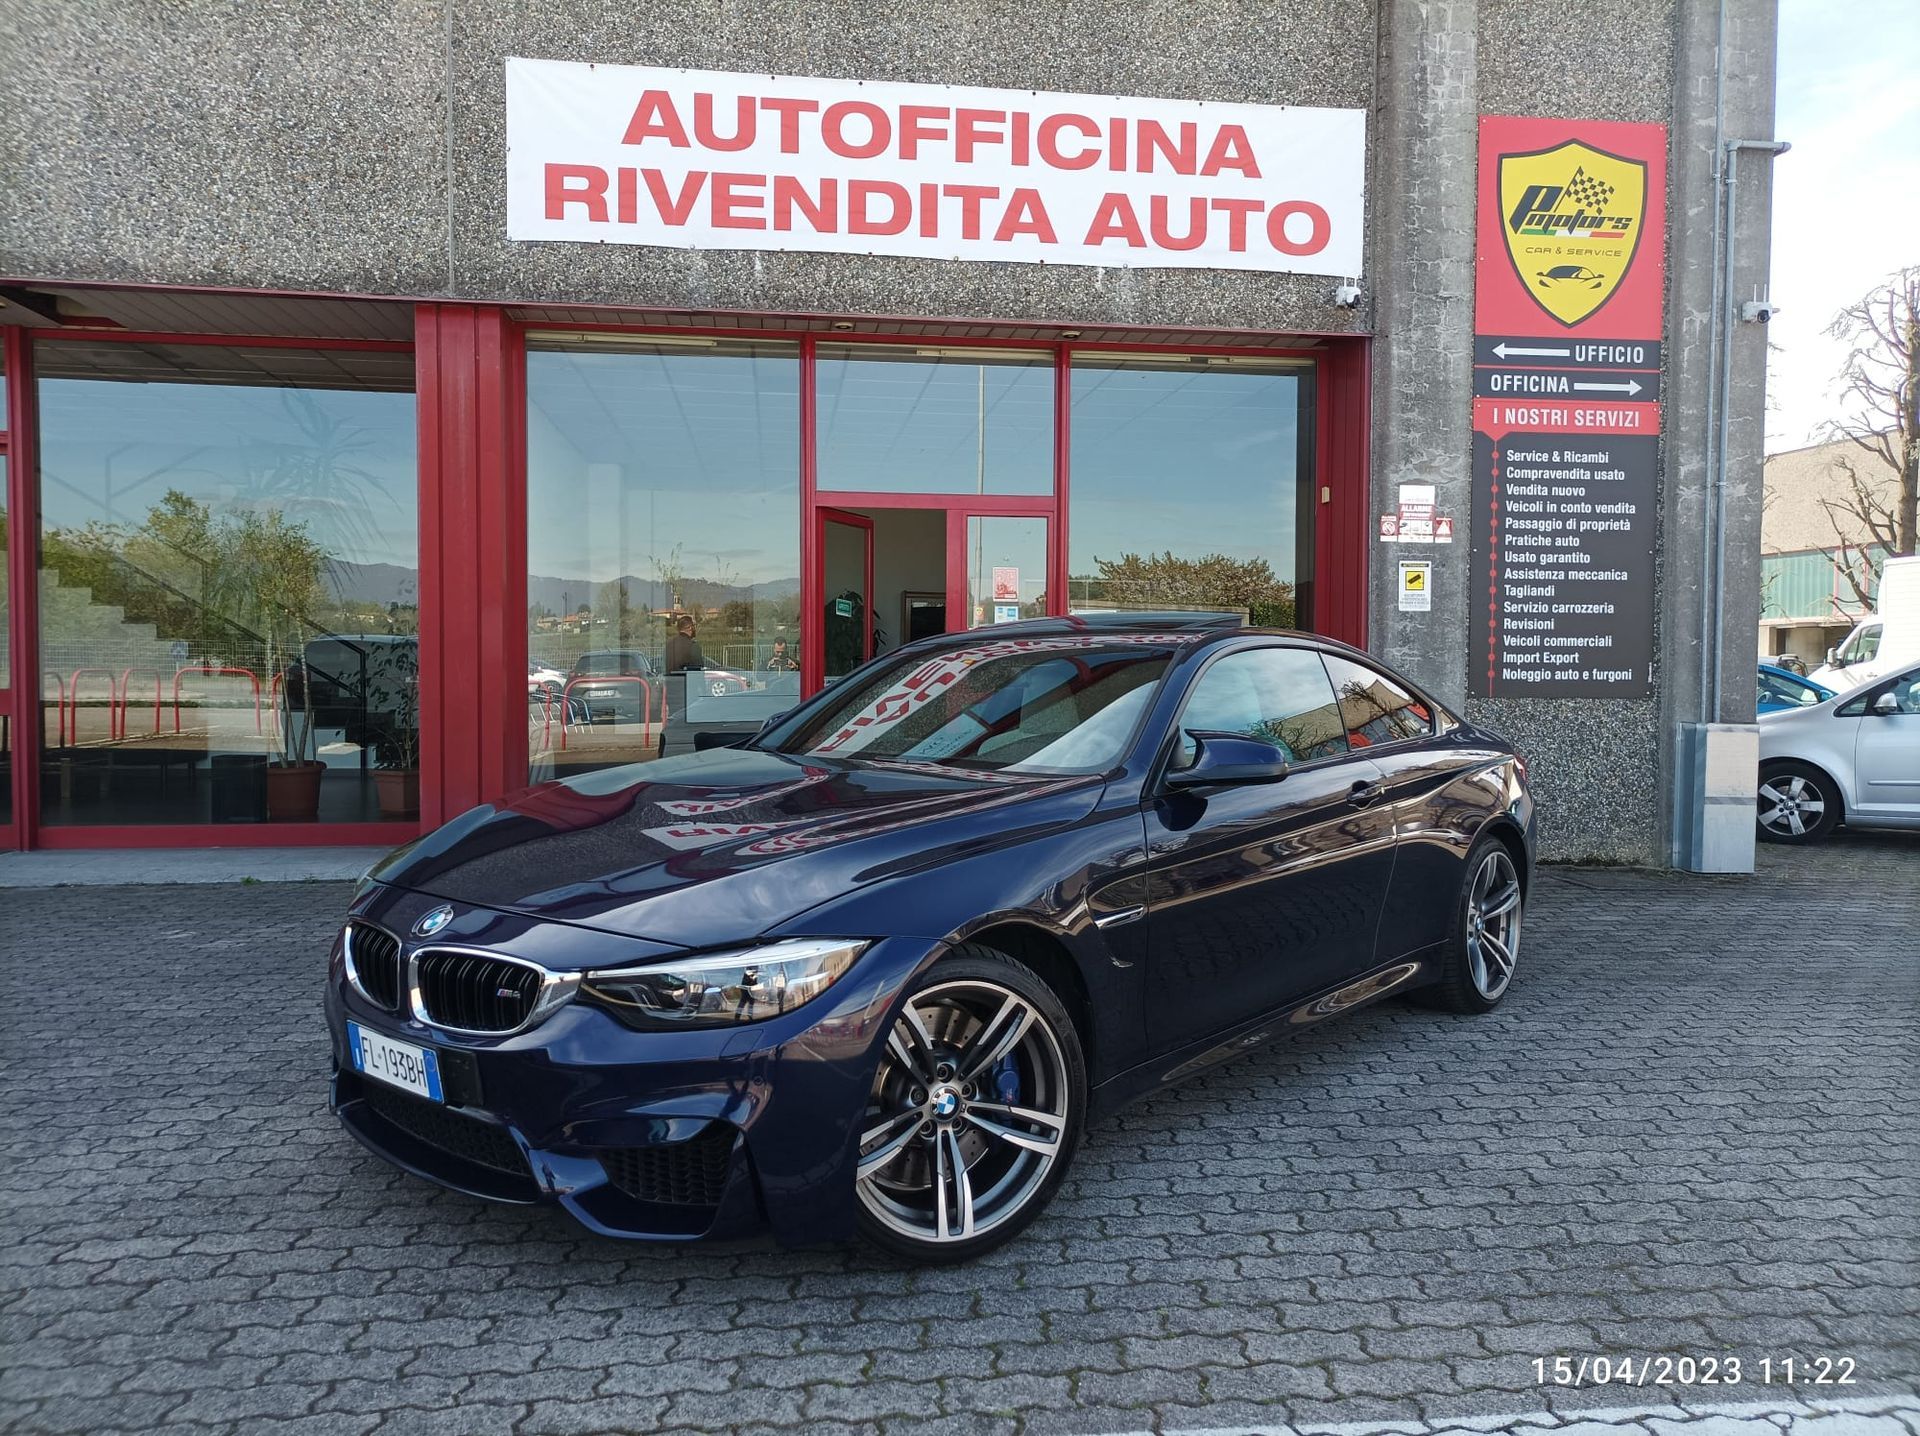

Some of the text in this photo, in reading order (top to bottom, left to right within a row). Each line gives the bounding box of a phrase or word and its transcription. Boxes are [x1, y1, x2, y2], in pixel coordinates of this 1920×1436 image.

[621, 89, 1261, 178] AUTOFFICINA
[543, 163, 1331, 256] RIVENDITA AUTO
[1525, 246, 1623, 257] CAR & SERVICE
[1575, 345, 1644, 364] UFFICIO
[1490, 374, 1570, 393] OFFICINA
[1493, 407, 1639, 427] I NOSTRI SERVIZI
[1507, 450, 1609, 463] Service & Ricambi
[1507, 467, 1625, 480] Compravendita usato
[1506, 484, 1586, 496] Vendita nuovo
[1506, 501, 1636, 514] Veicoli in conto vendita
[1505, 517, 1631, 532] Passaggio di proprietà
[1505, 534, 1580, 547] Pratiche auto
[1505, 551, 1591, 565] Usato garantito
[1505, 568, 1628, 580] Assistenza meccanica
[1504, 585, 1555, 598] Tagliandi
[1504, 601, 1615, 614] Servizio carrozzeria
[1504, 618, 1555, 630] Revisioni
[1504, 635, 1613, 647] Veicoli commerciali
[1504, 652, 1580, 666] Import Export
[1503, 668, 1632, 682] Noleggio auto e furgoni
